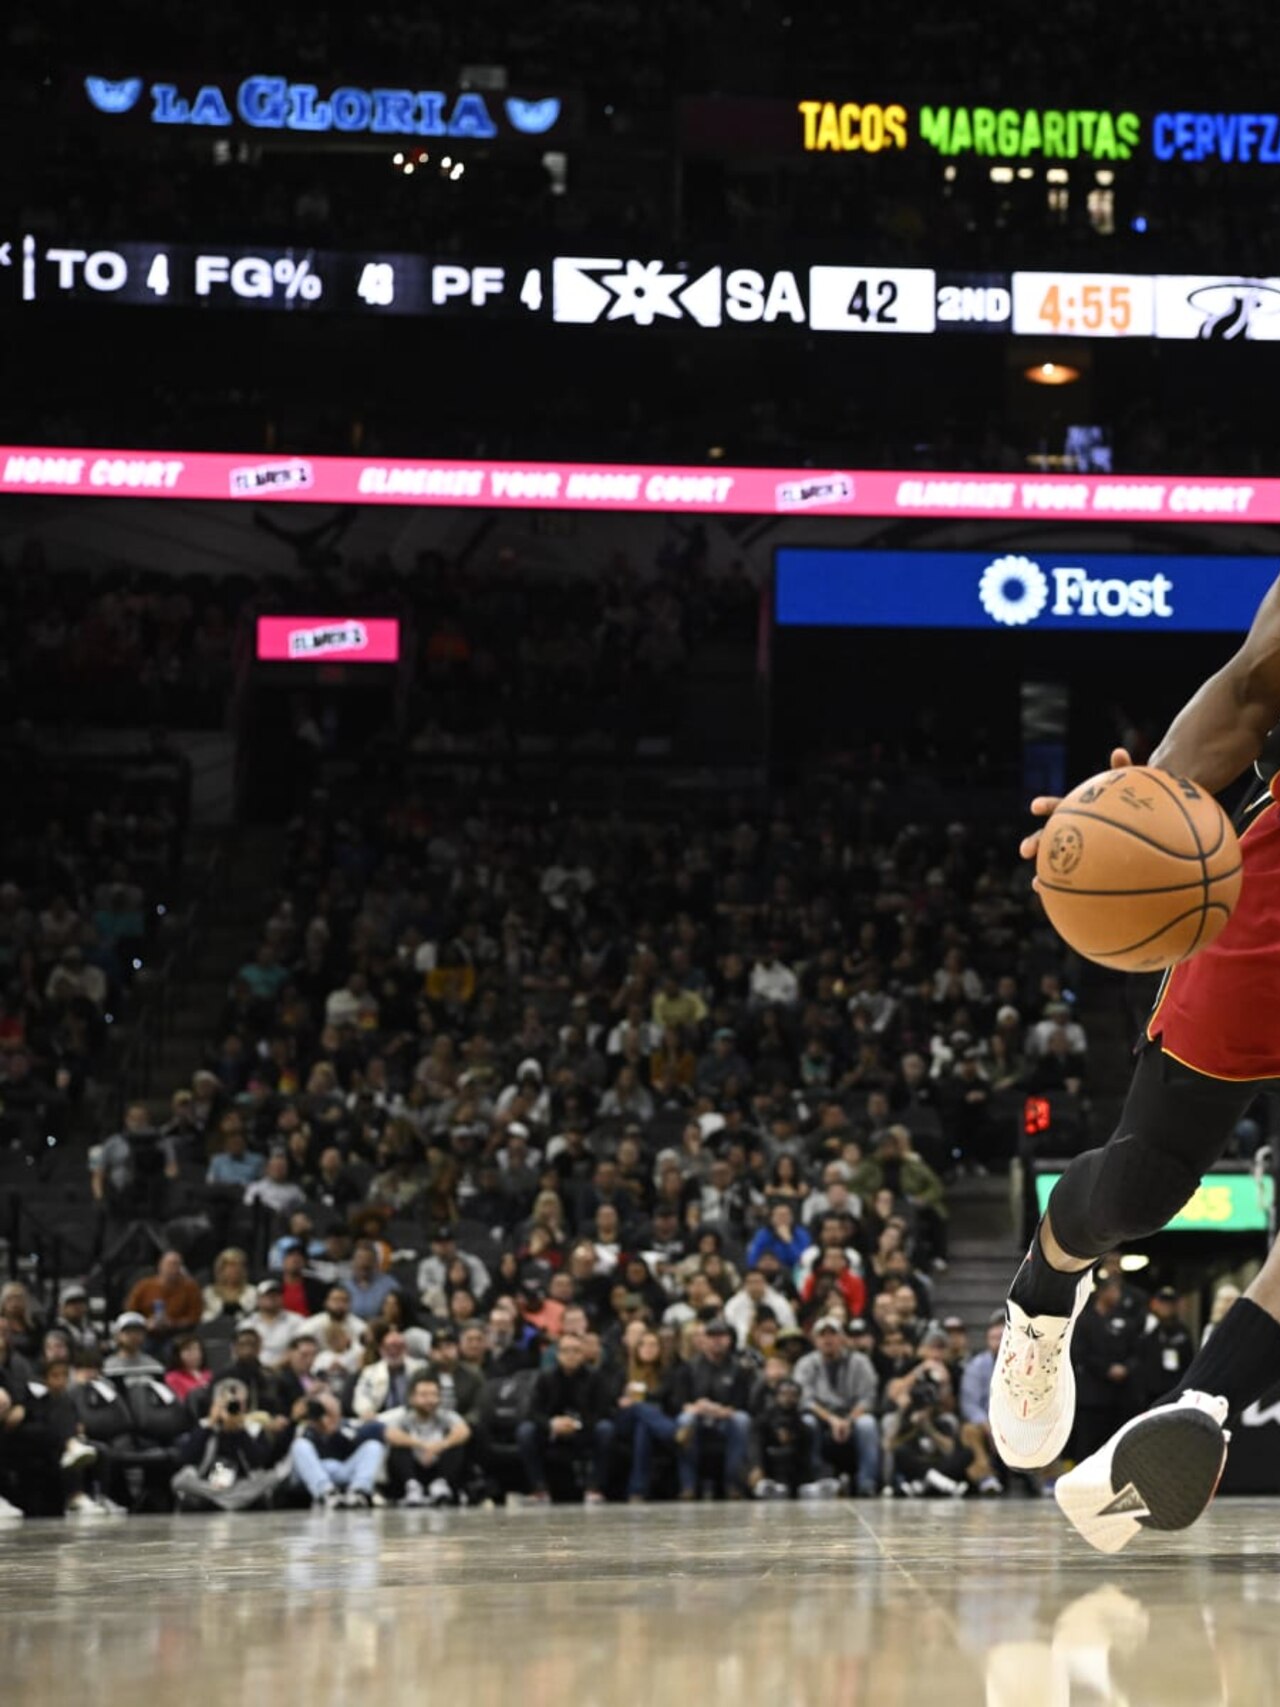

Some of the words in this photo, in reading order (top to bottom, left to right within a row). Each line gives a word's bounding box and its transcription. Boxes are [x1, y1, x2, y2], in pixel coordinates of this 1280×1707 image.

[152, 86, 231, 125] LA
[238, 76, 498, 138] GLORIA
[799, 102, 907, 152] TACOS
[920, 106, 1140, 160] MARGARITAS
[46, 248, 128, 291] TO
[195, 257, 321, 299] FG%
[432, 264, 505, 306] PF
[725, 269, 805, 322] SA
[847, 280, 897, 323] 42
[937, 286, 1011, 322] 2ND
[1038, 284, 1132, 332] 4:55
[90, 461, 184, 487] COURT
[645, 475, 734, 503] COURT
[1051, 567, 1173, 617] Frost
